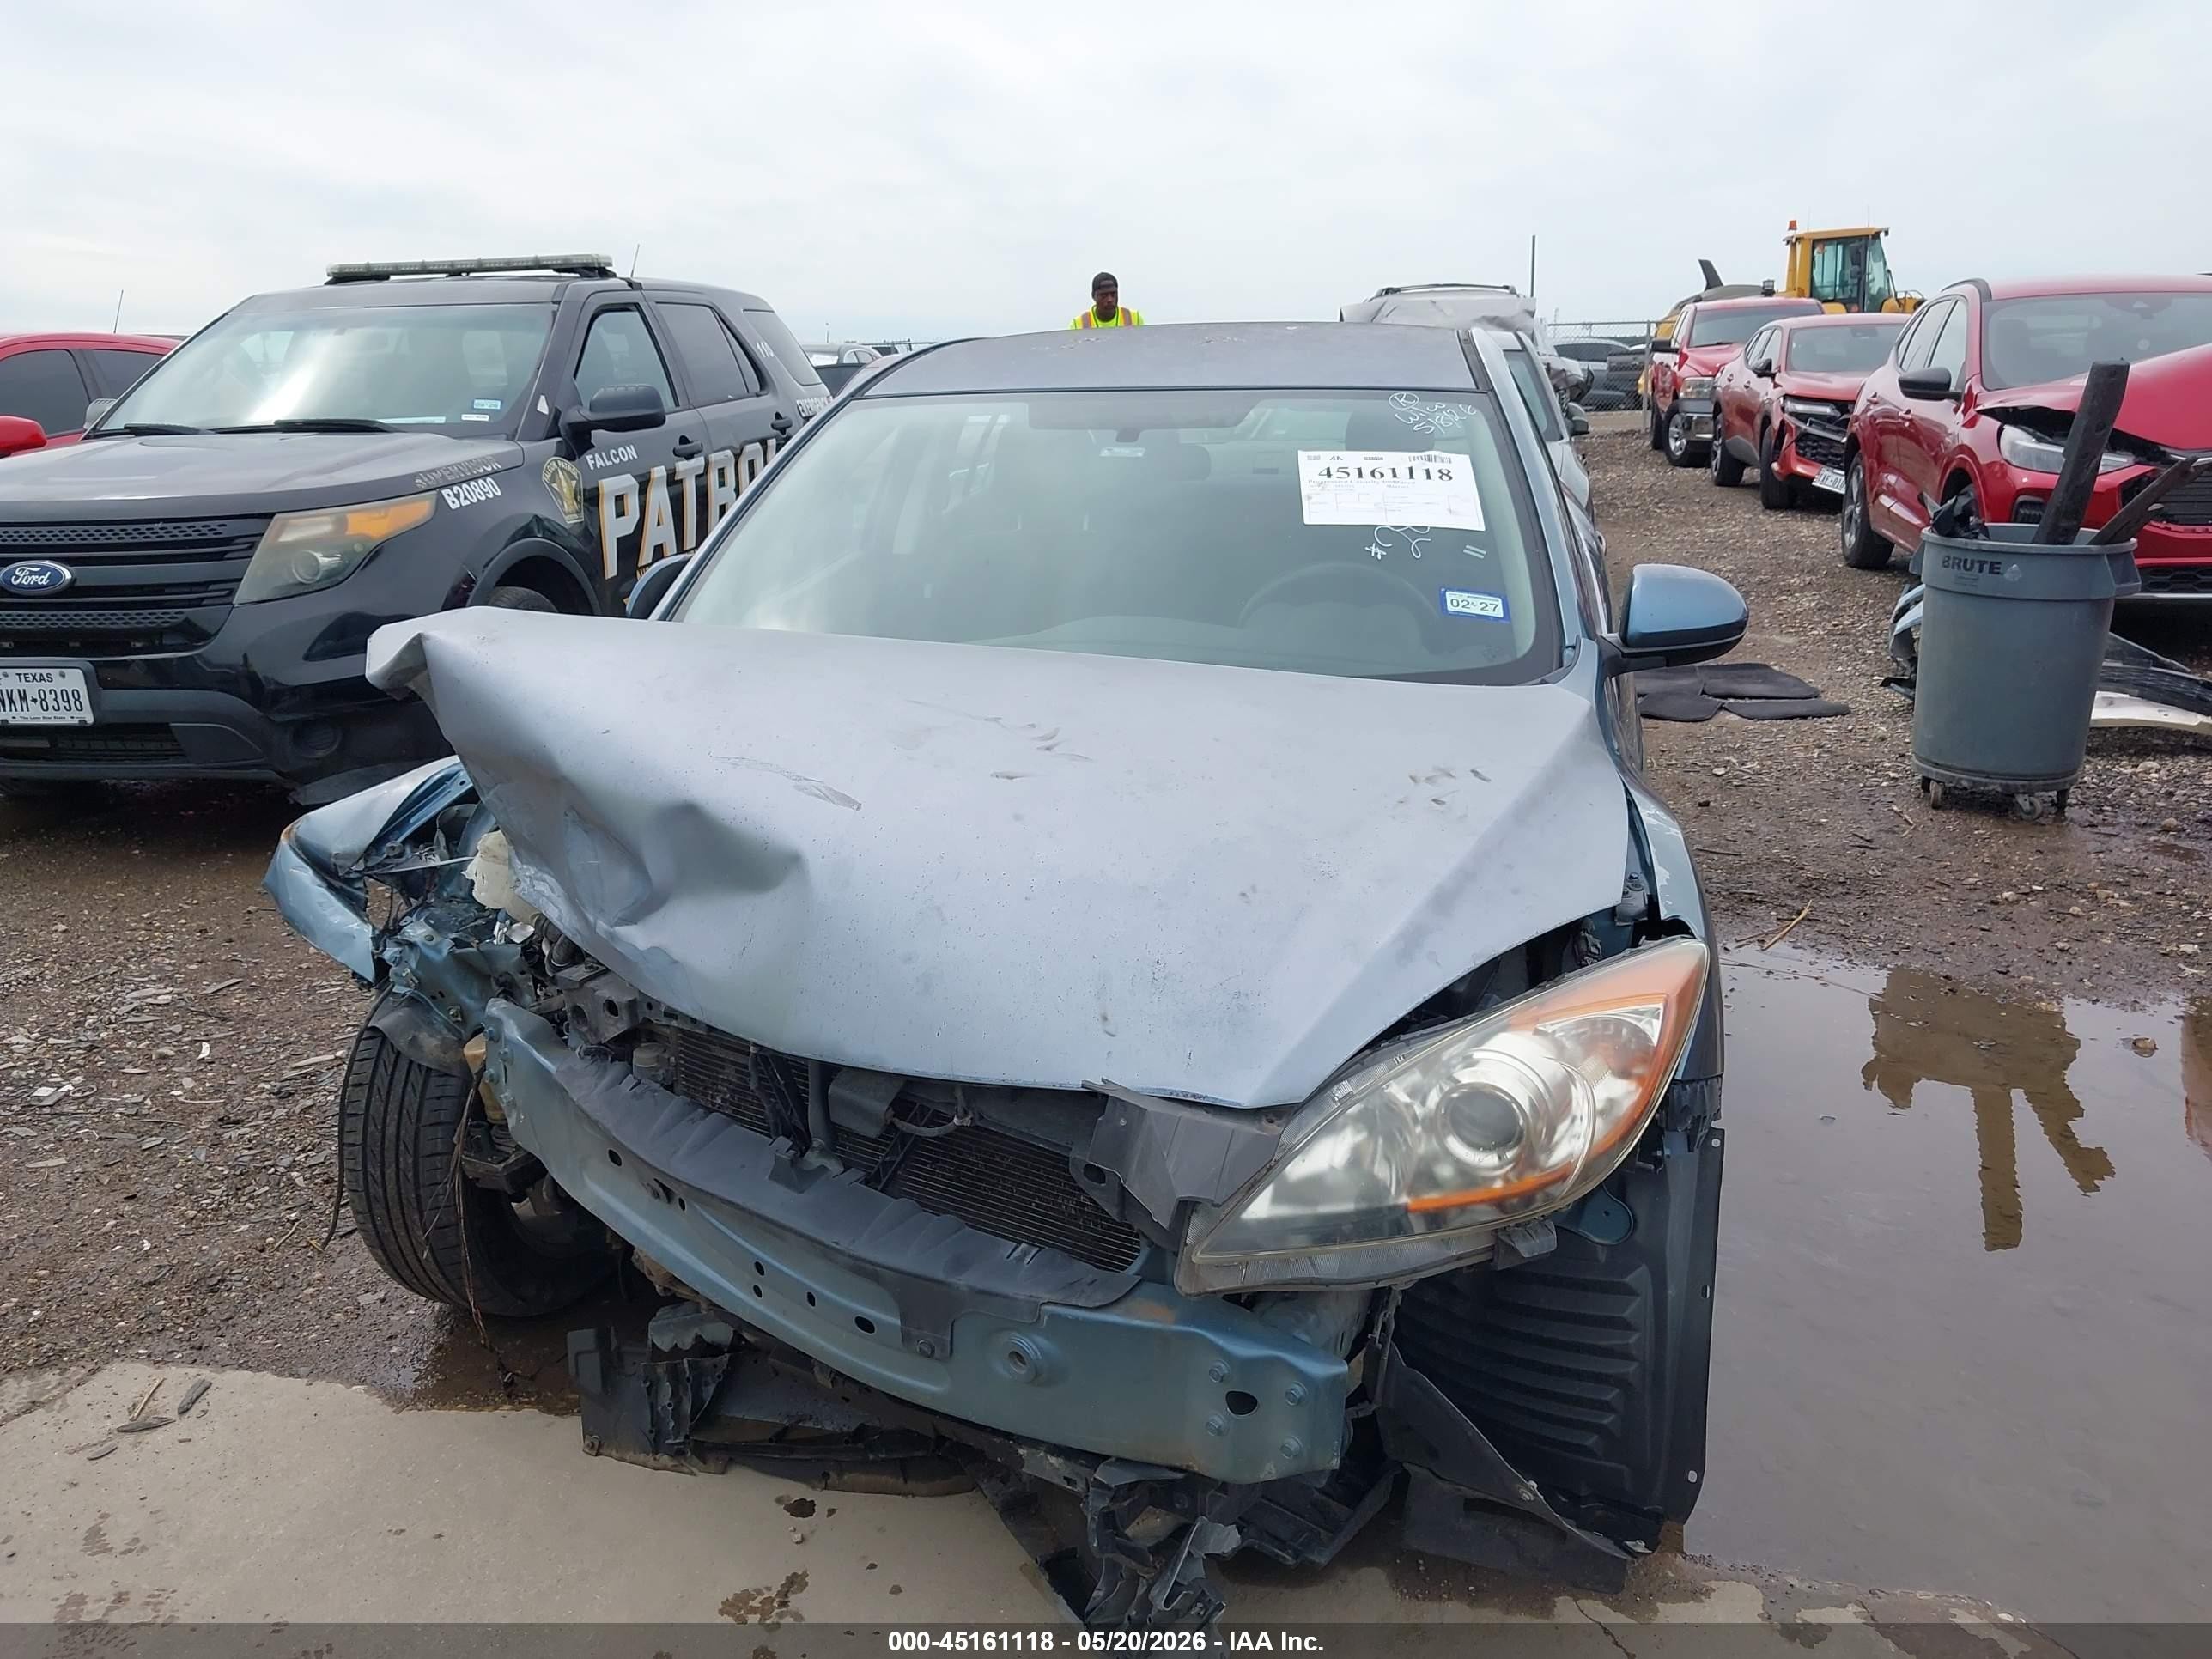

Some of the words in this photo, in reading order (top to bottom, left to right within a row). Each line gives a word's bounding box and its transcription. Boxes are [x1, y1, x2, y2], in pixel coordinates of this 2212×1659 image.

[586, 444, 639, 471] FALCON
[1318, 465, 1453, 482] 45161118
[441, 477, 502, 510] B20890
[1942, 555, 2002, 575] BRUTE
[11, 567, 52, 585] Ford
[15, 672, 54, 683] TEXAS
